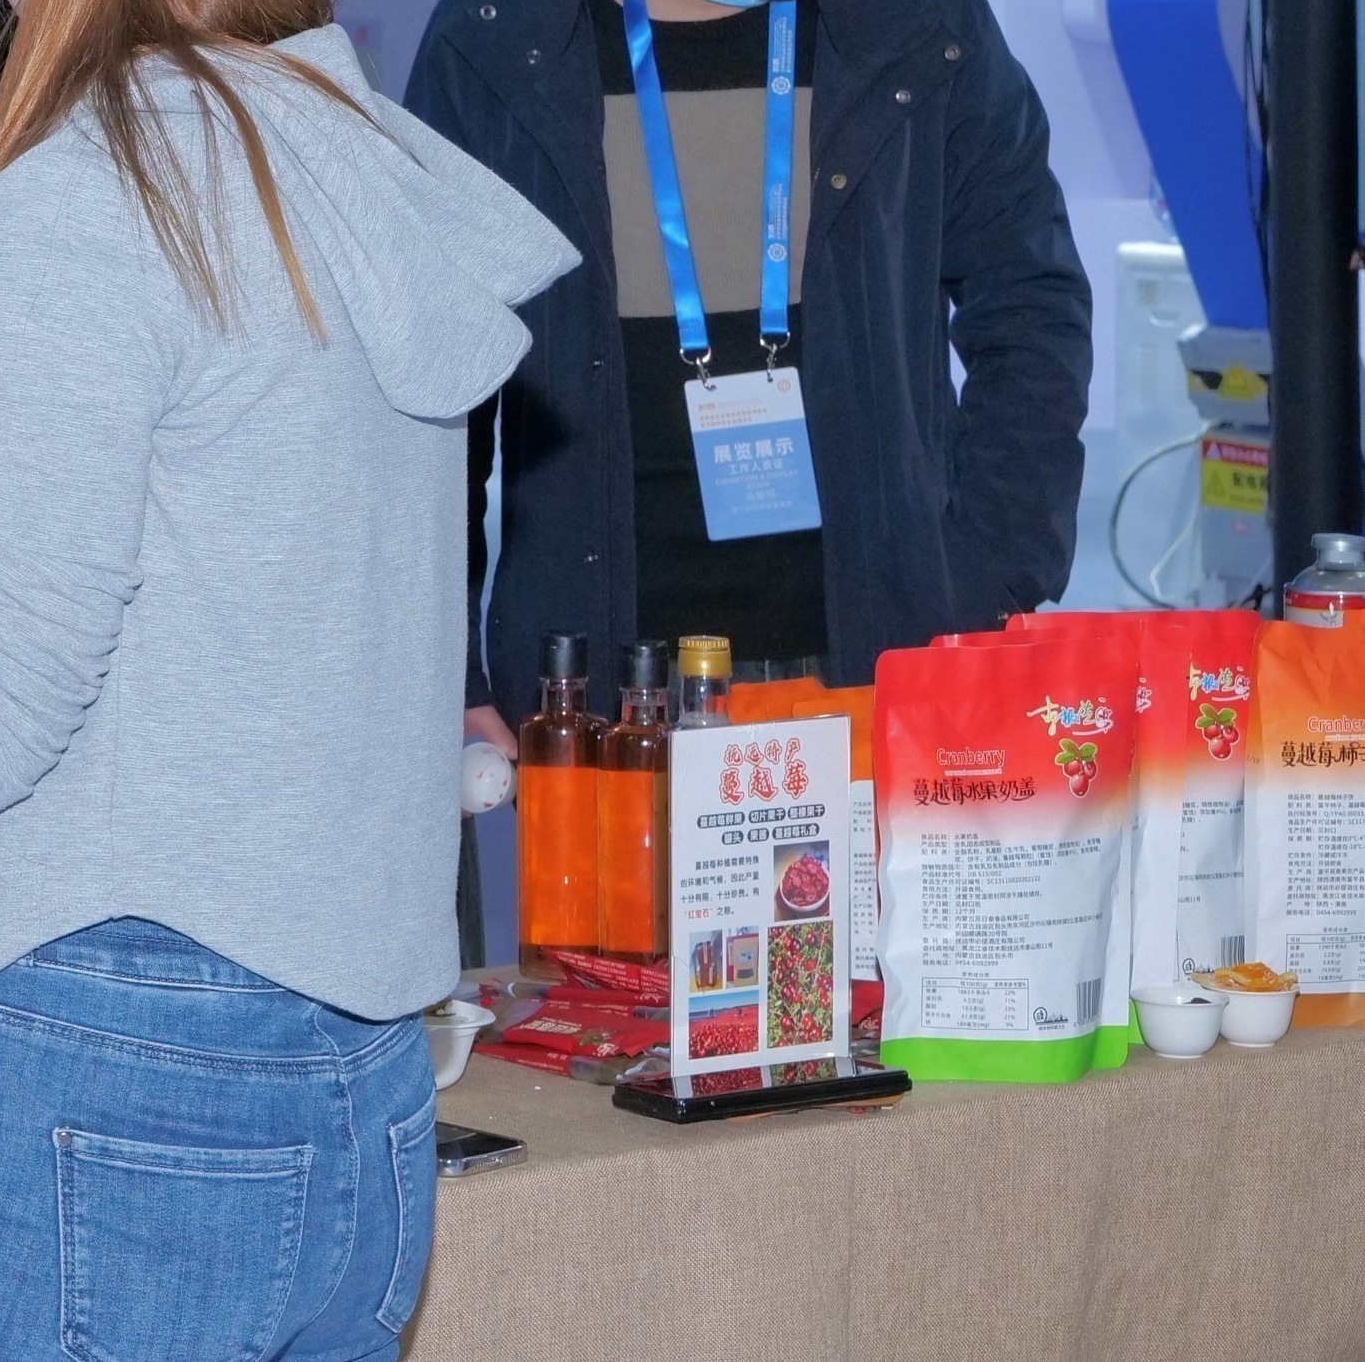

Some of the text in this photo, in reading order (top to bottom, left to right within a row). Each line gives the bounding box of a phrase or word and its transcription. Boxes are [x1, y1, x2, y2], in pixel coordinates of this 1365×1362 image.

[714, 437, 795, 463] 展览展示
[729, 459, 784, 475] 工作人员证
[724, 738, 801, 766] 抚远特产
[937, 746, 1006, 767] Cranberry
[720, 760, 809, 806] 蔓越莓
[913, 776, 1038, 806] 蔓越莓水果奶盖
[699, 812, 744, 828] 蔓越莓鲜果
[750, 808, 785, 823] 切片果干
[723, 823, 819, 844] 罐头 果酱 蔓越莓礼盒
[695, 855, 760, 871] 蔓越莓种植需要特殊
